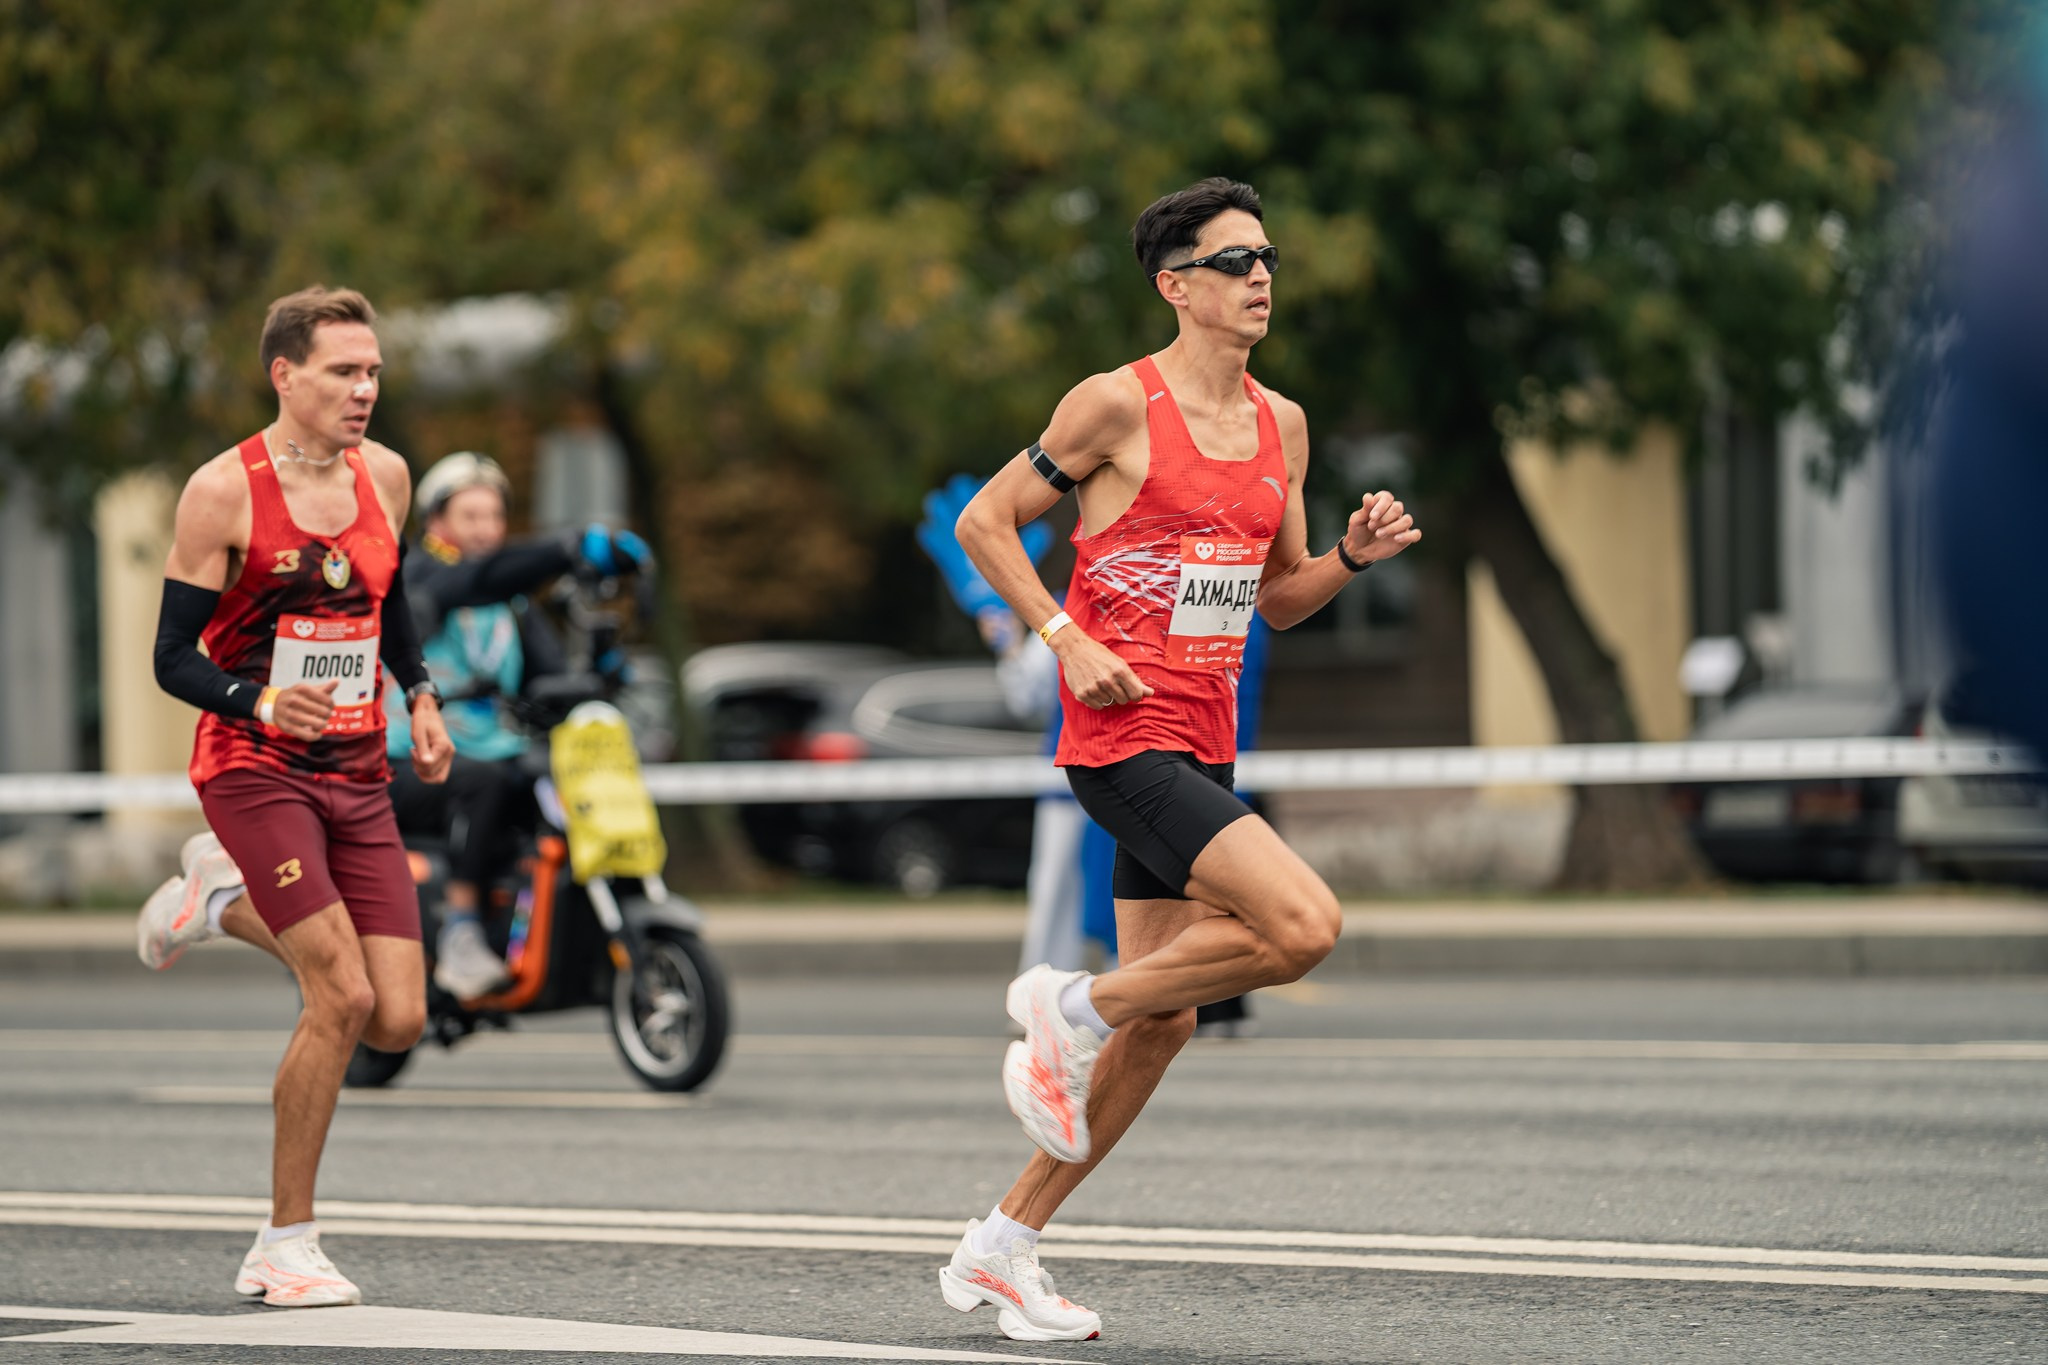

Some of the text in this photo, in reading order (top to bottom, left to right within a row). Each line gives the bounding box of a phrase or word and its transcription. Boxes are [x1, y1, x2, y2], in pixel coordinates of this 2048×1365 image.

[1181, 578, 1260, 612] АХМАДЕ
[1221, 621, 1228, 631] 3
[302, 653, 364, 678] ПОПОВ
